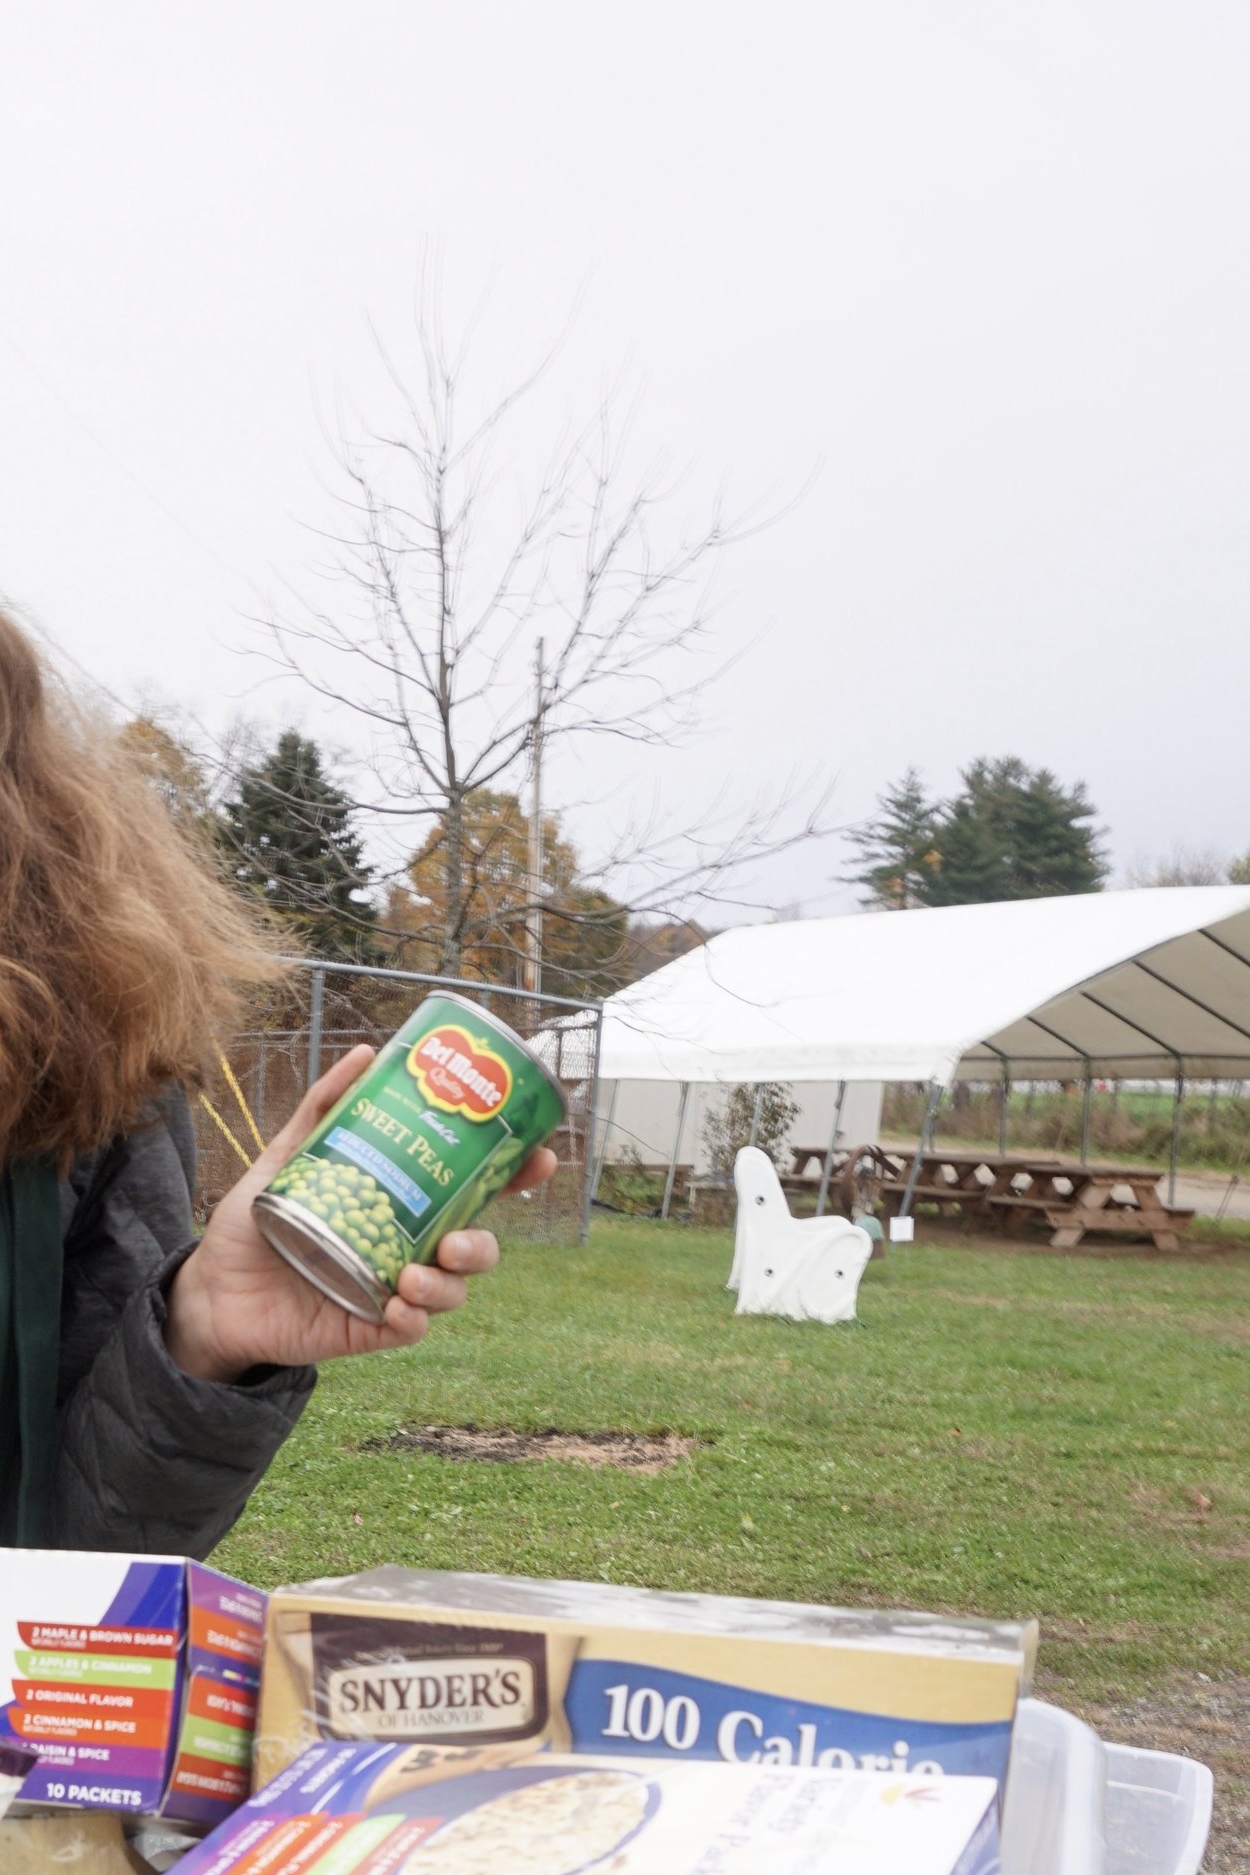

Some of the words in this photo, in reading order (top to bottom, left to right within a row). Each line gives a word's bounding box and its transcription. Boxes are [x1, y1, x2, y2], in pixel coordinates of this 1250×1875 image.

[419, 1036, 449, 1064] Del
[446, 1051, 503, 1108] Monte
[350, 1097, 414, 1146] SWEET
[405, 1133, 455, 1187] PEAS
[41, 1627, 79, 1642] MAPLE
[88, 1630, 133, 1645] BROWN
[133, 1633, 175, 1648] SUGAR
[34, 1689, 88, 1706] ORIGINAL
[88, 1693, 135, 1708] FLAVOR
[340, 1668, 522, 1714] SNYDER'S
[31, 1713, 93, 1730] CINNAMON
[103, 1718, 137, 1734] SPICE
[379, 1712, 398, 1729] OF
[403, 1709, 486, 1728] HANOVER
[602, 1681, 701, 1753] 100
[77, 1746, 111, 1761] SPICE
[46, 1782, 66, 1799] 10
[67, 1784, 143, 1807] PACKETS
